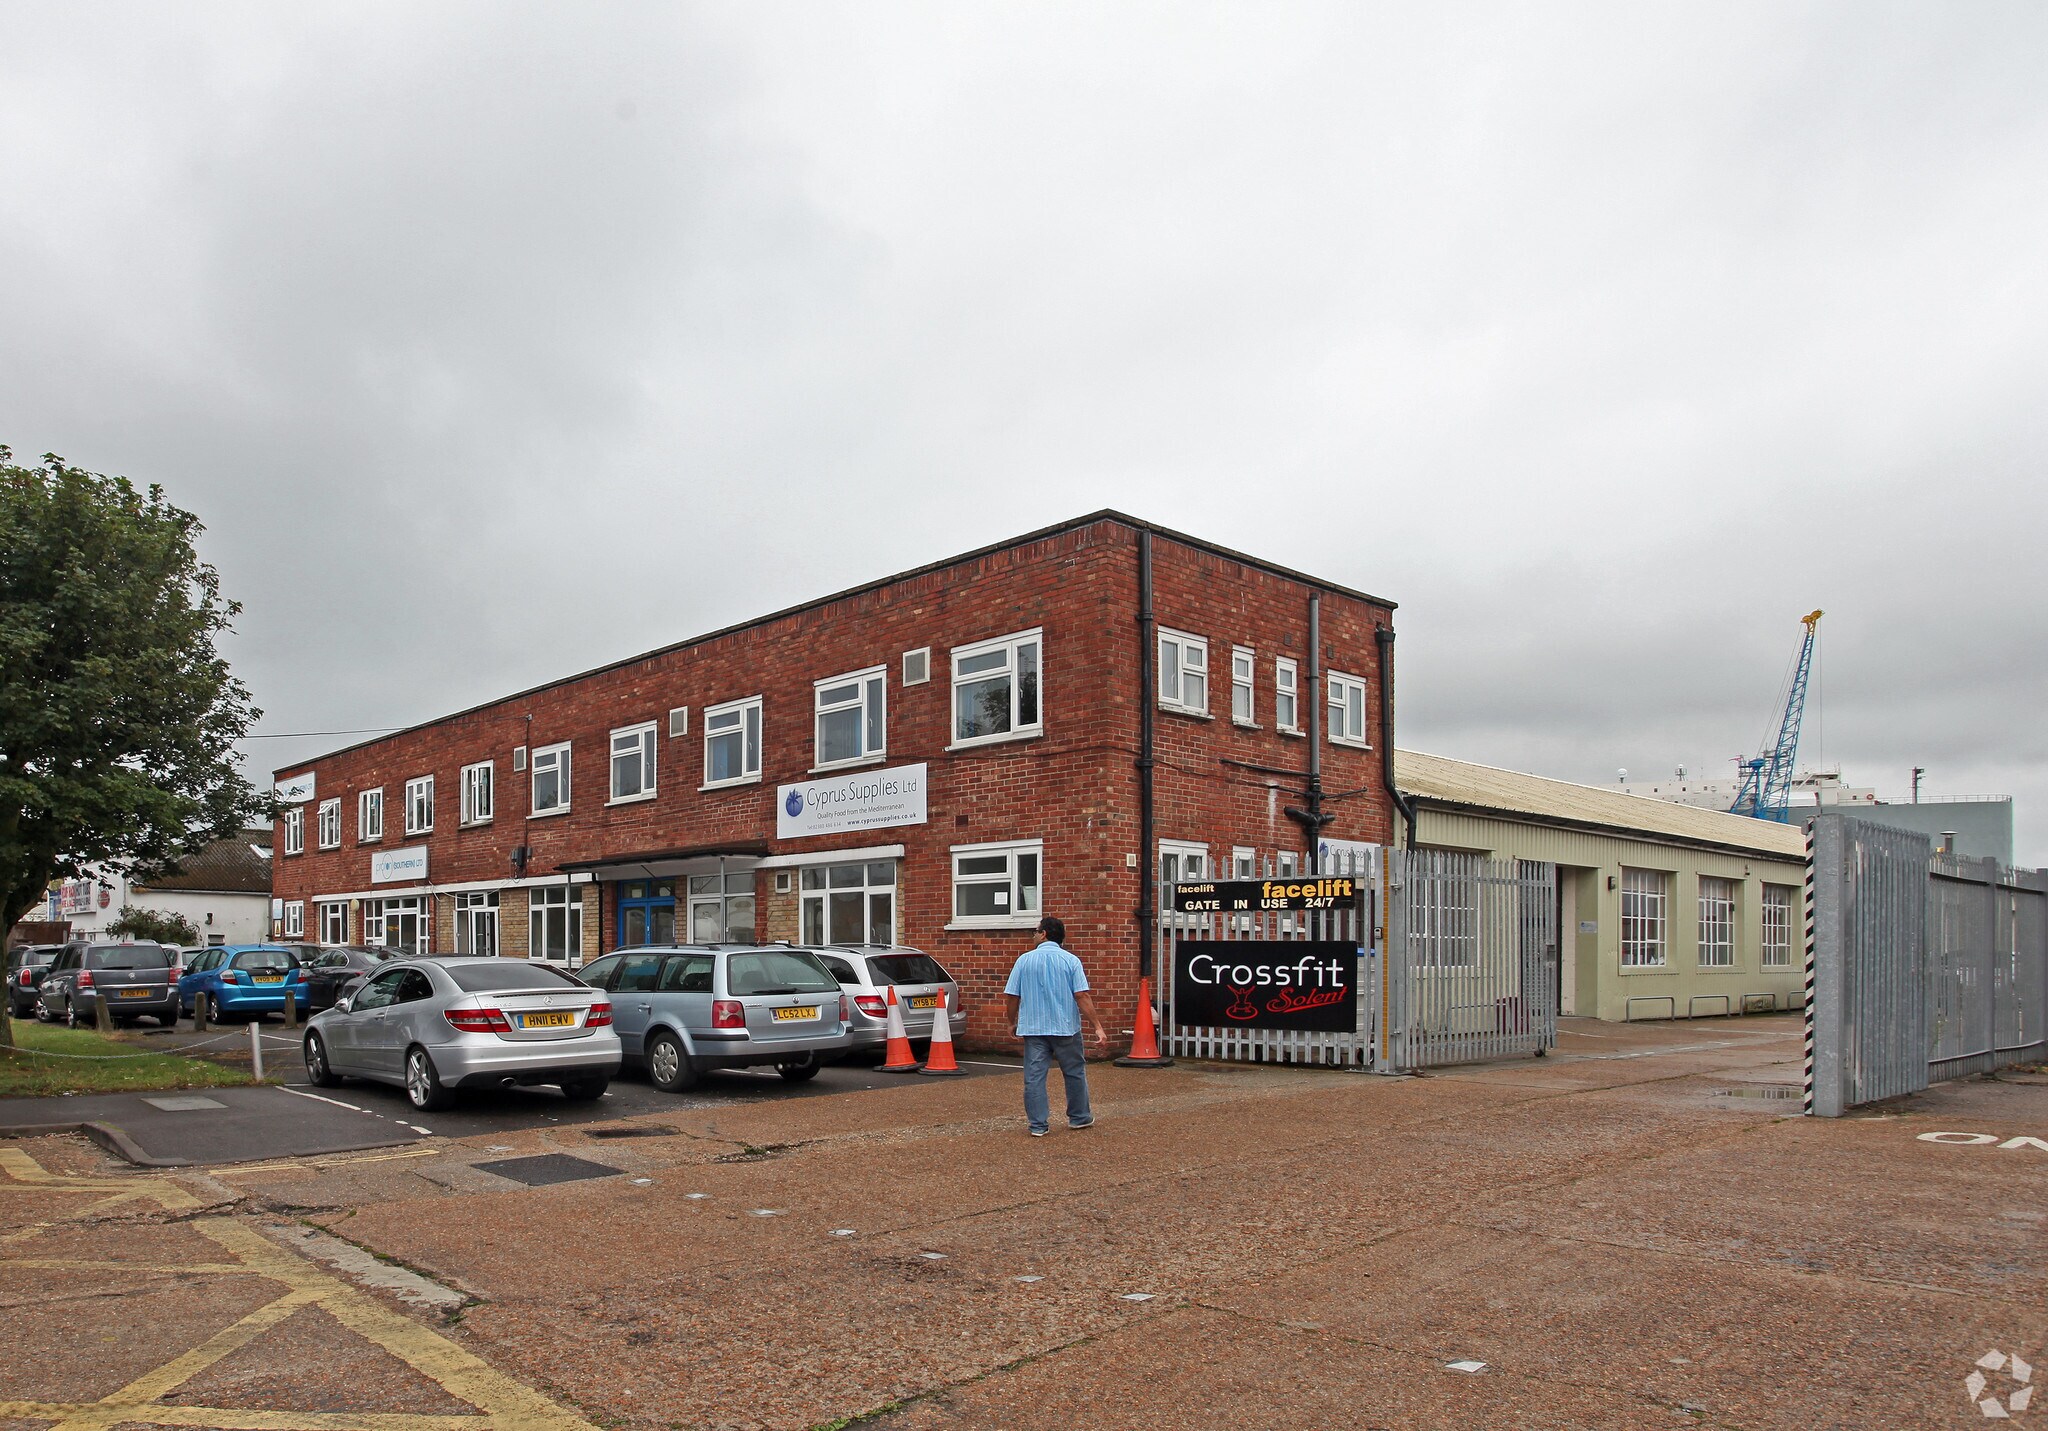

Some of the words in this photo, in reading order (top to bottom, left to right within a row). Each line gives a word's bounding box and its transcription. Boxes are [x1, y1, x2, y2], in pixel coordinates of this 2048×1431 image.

[807, 787, 846, 810] Cyprus
[849, 777, 898, 804] Supplies
[902, 778, 917, 793] Ltd
[817, 812, 834, 820] Quality
[847, 808, 858, 816] from
[868, 803, 905, 813] Mediterranean
[847, 812, 917, 826] www.cyprussupplies.co.uk
[1178, 884, 1215, 894] facelift
[1262, 879, 1352, 899] facelift
[1185, 900, 1220, 911] GATE
[1234, 899, 1248, 909] IN
[1260, 898, 1288, 909] USE
[1305, 897, 1335, 908] 24/7
[1188, 954, 1344, 987] Crossfit
[1266, 985, 1348, 1013] Solent
[777, 1007, 800, 1020] LC52
[801, 1006, 817, 1018] LXJ
